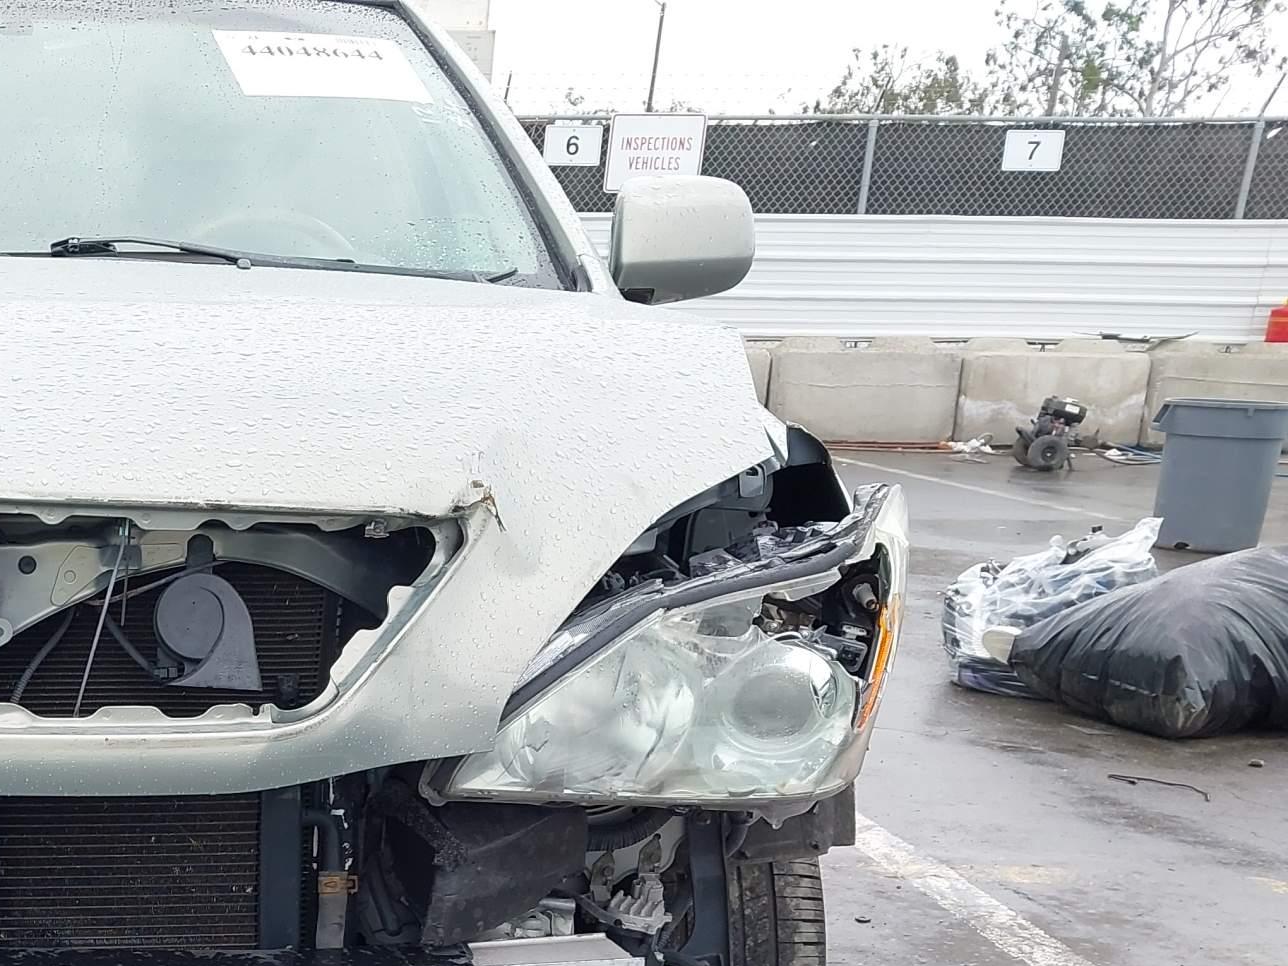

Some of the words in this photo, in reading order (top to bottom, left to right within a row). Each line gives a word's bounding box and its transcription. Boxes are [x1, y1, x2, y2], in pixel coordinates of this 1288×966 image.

[566, 135, 580, 155] 6
[620, 136, 694, 151] INSPECTIONS
[1027, 140, 1041, 161] 7
[627, 156, 681, 171] VEHICLES
